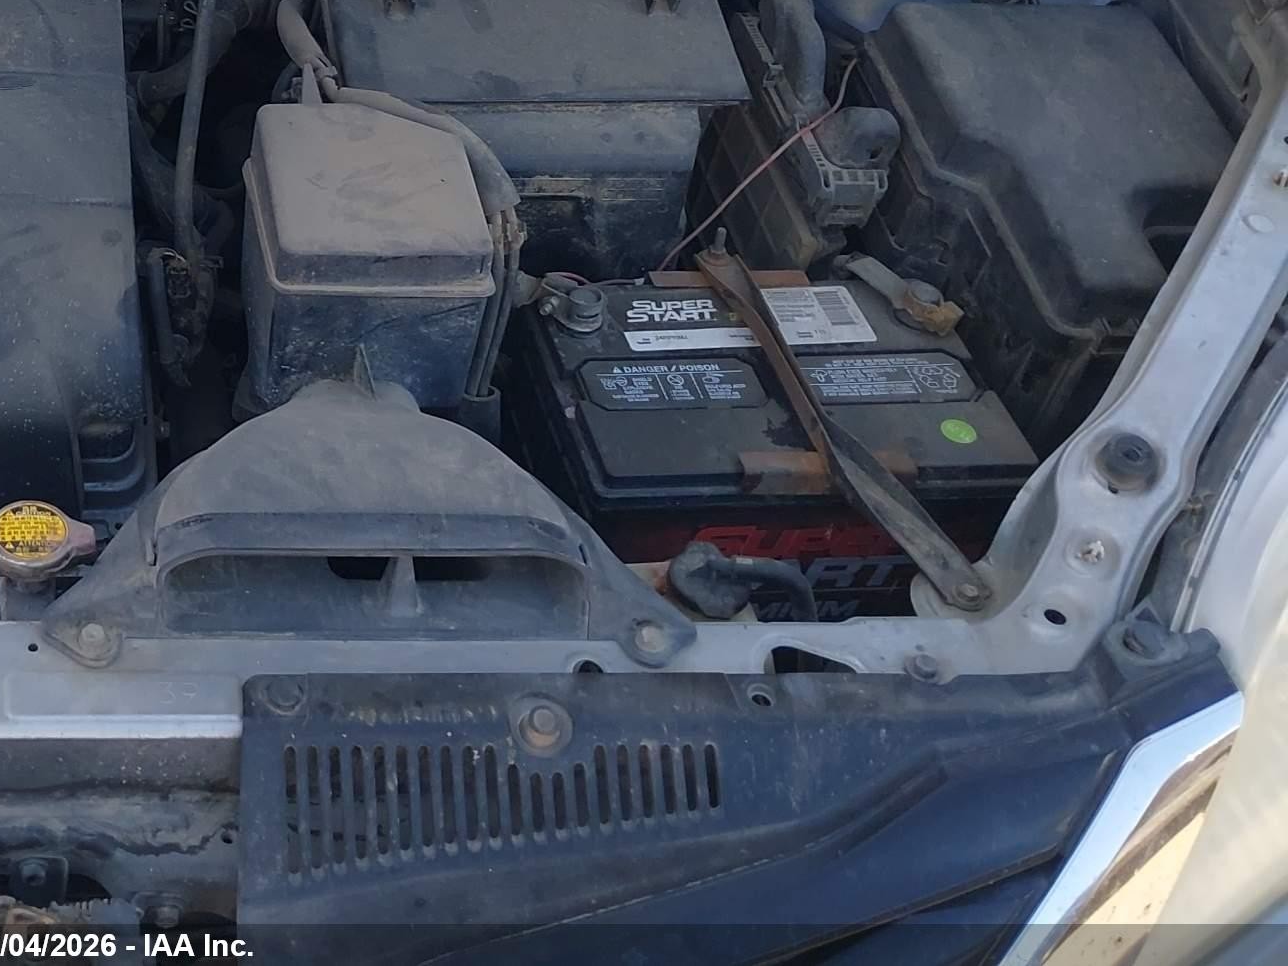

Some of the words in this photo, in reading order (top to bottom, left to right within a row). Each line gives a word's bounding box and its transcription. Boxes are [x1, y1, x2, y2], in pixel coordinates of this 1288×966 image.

[632, 299, 714, 312] SUPER
[623, 365, 669, 374] DANGER
[679, 363, 721, 372] POISON
